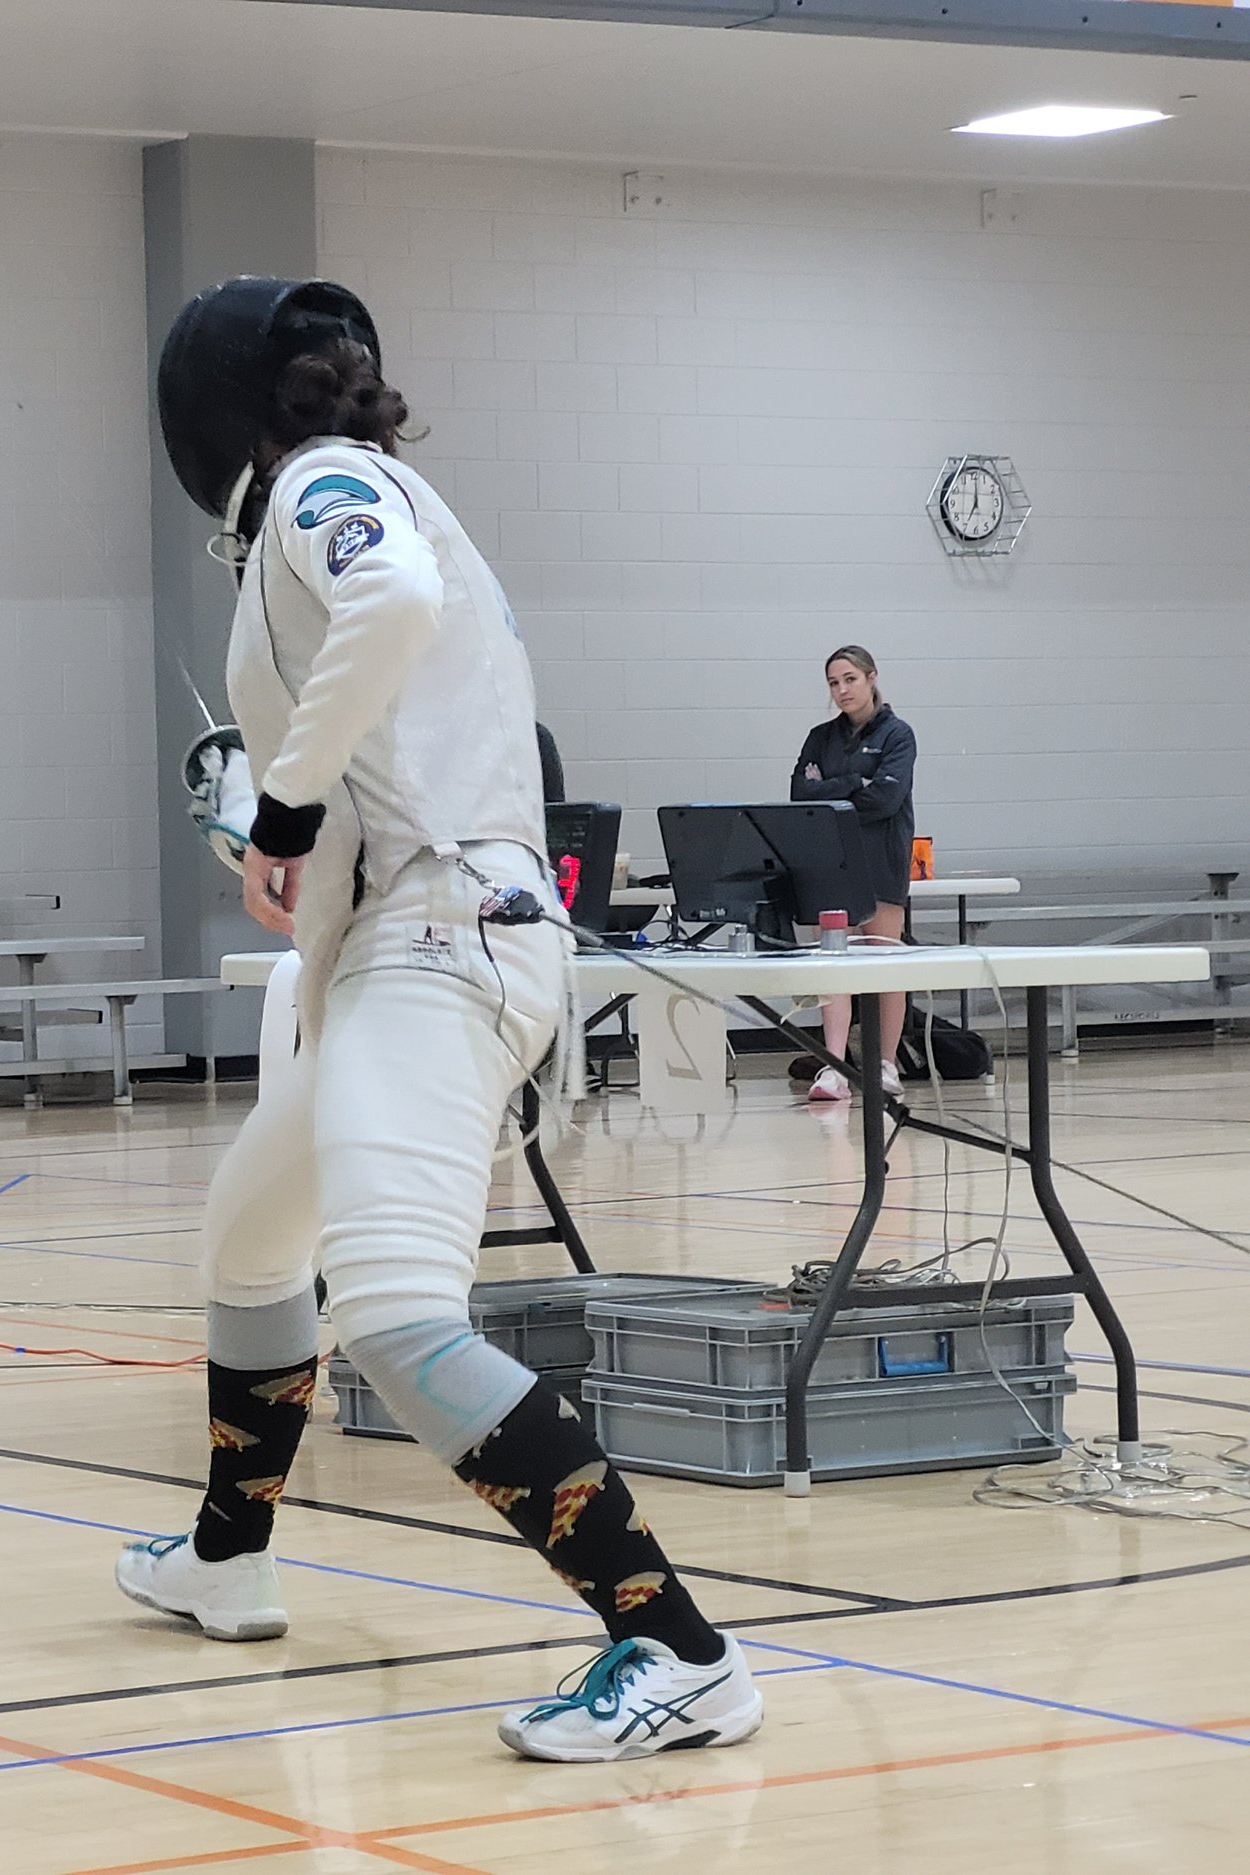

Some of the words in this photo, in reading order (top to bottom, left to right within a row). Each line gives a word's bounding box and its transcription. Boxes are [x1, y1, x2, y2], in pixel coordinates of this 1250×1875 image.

[990, 484, 995, 494] 2
[950, 500, 956, 509] 9
[994, 498, 999, 507] 3
[953, 512, 959, 521] 8
[991, 511, 996, 520] 4
[962, 523, 968, 532] 7
[973, 525, 979, 534] 6
[983, 522, 989, 532] 5
